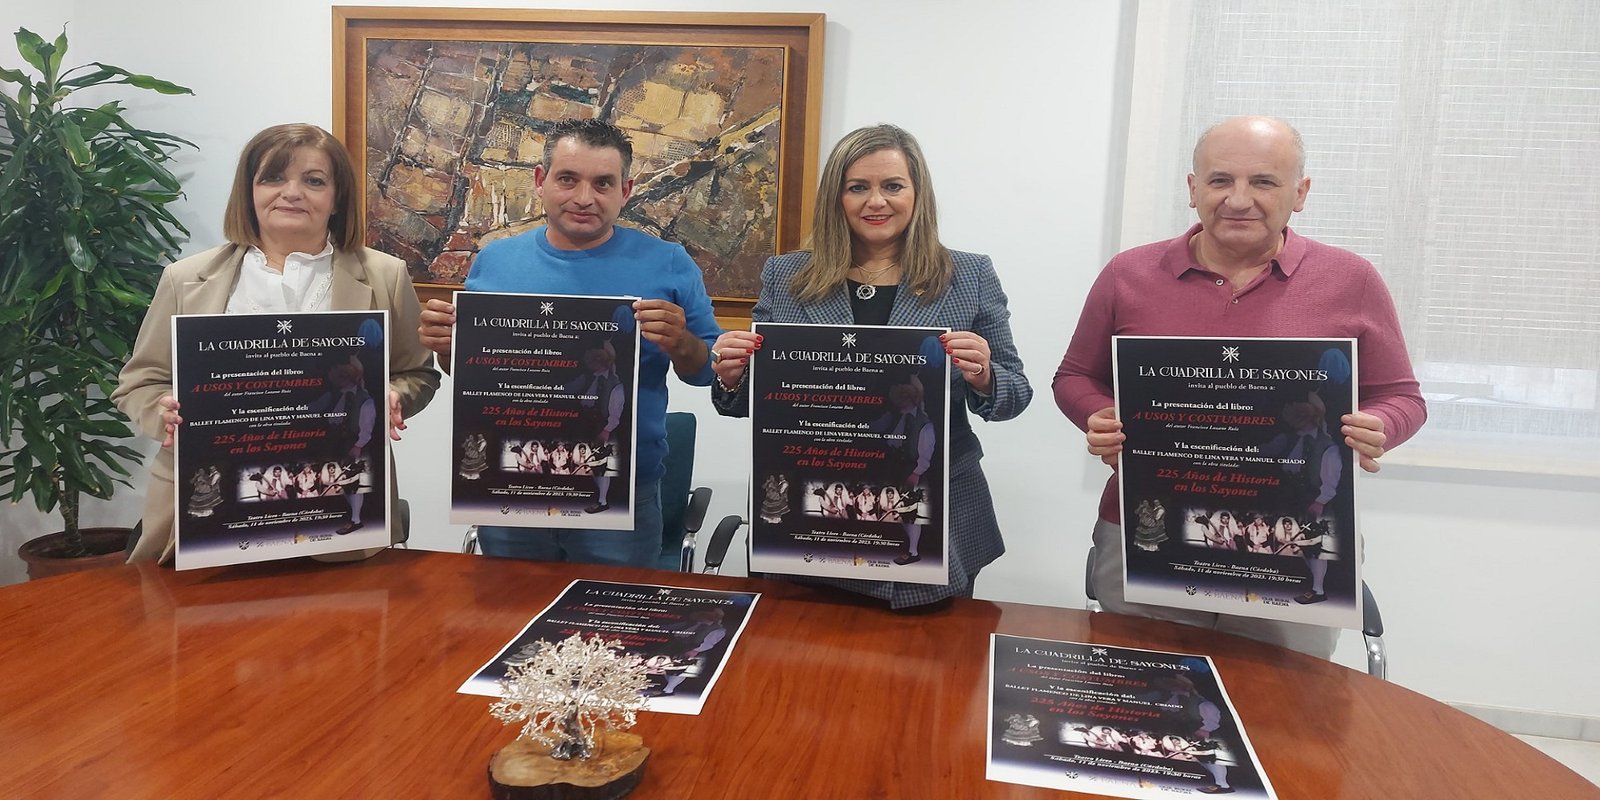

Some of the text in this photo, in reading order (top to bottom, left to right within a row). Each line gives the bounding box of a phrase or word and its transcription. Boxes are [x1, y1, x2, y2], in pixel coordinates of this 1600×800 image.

[473, 317, 619, 332] LA CUADRILLA DE SAYONES
[199, 336, 365, 351] LA CUADRILLA DE SAYONES
[492, 348, 532, 356] presentación
[772, 350, 927, 365] LA CUADRILLA DE SAYONES
[222, 370, 269, 379] presentación
[1139, 366, 1328, 382] LA CUADRILLA DE SAYONES
[202, 383, 234, 392] USOS
[236, 382, 243, 390] Y
[245, 378, 323, 389] COSTUMBRES
[792, 382, 833, 391] presentación
[1215, 383, 1237, 391] pueblo
[774, 393, 801, 401] USOS
[811, 394, 884, 405] COSTUMBRES
[1164, 401, 1214, 411] presentación
[246, 405, 294, 414] escenificación
[483, 406, 579, 417] 225 Años de Historia
[510, 418, 522, 426] los
[524, 418, 562, 430] Sayones
[812, 420, 856, 429] escenificación
[1133, 412, 1276, 426] A USOS Y COSTUMBRES
[214, 429, 326, 444] 225 Años de Historia
[247, 444, 261, 453] los
[264, 440, 307, 454] Sayones
[783, 445, 885, 459] 225 Años de Historia
[1190, 442, 1243, 452] escenificación
[1245, 445, 1259, 453] del:
[812, 458, 824, 467] los
[827, 458, 867, 472] Sayones
[1157, 469, 1280, 486] 225 Años de Historia
[1174, 483, 1258, 500] en los Sayones
[1034, 650, 1106, 662] CUADRILLA
[1130, 660, 1192, 672] SAYONES
[1038, 665, 1087, 674] presentación
